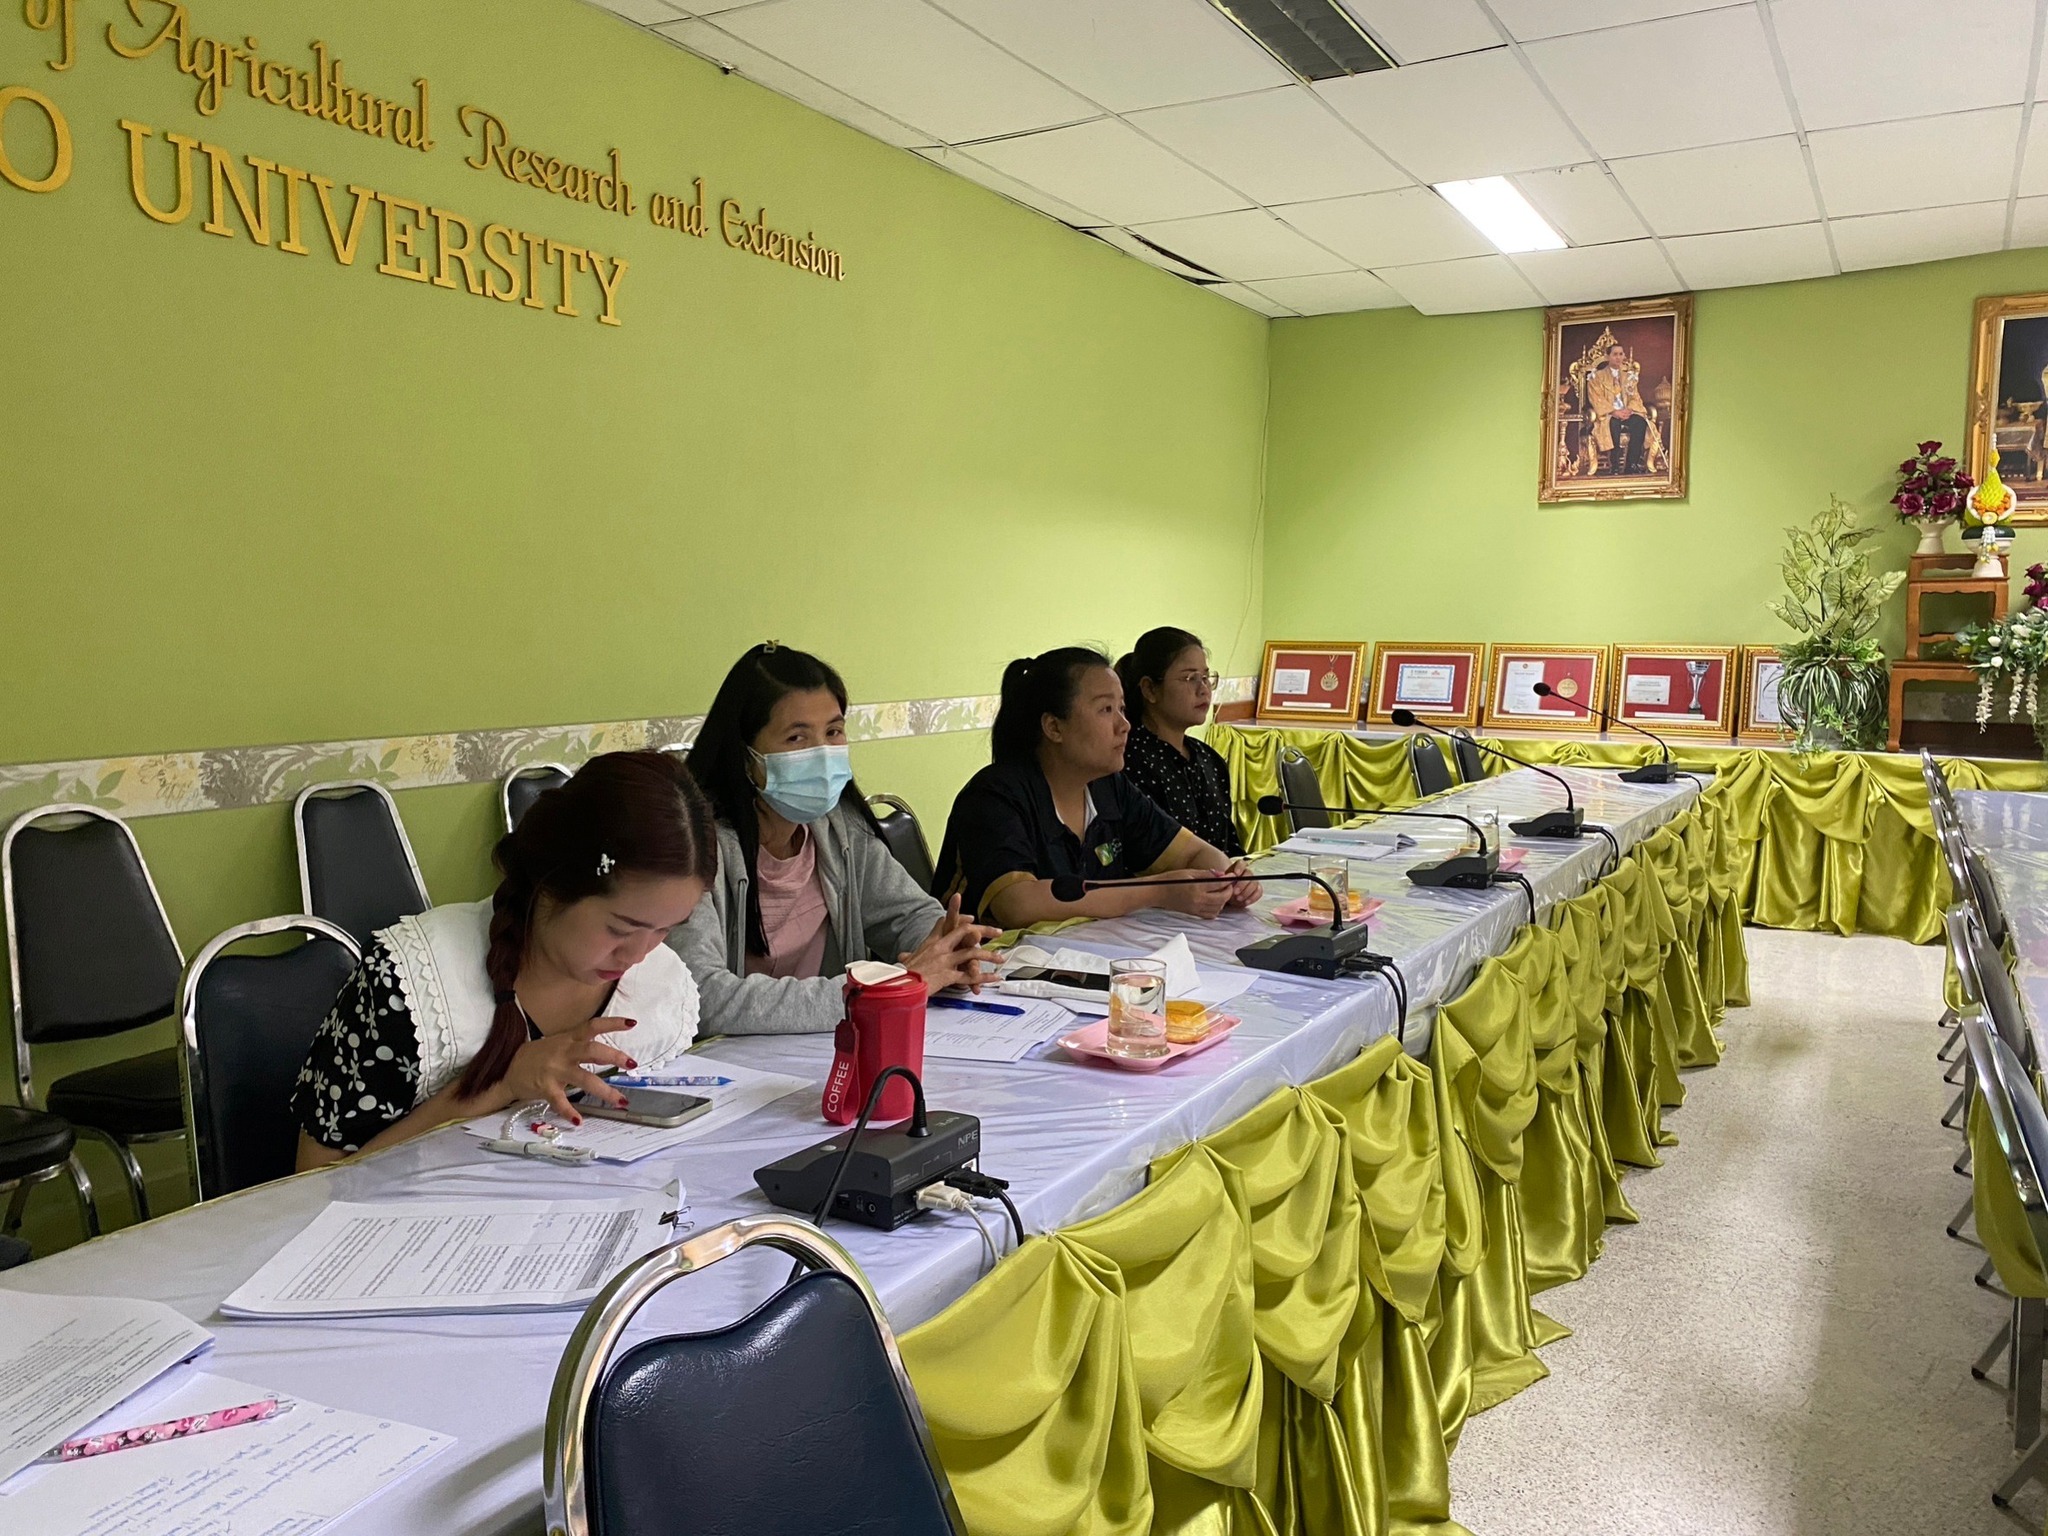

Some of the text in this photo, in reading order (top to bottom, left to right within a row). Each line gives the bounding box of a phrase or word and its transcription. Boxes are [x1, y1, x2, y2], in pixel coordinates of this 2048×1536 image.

[106, 0, 435, 152] Agricultural
[458, 104, 637, 216] Research
[650, 176, 709, 238] and
[720, 198, 846, 281] Extension
[119, 118, 629, 326] UNIVERSITY
[827, 1061, 850, 1113] COFFEE
[957, 1129, 979, 1146] NPE
